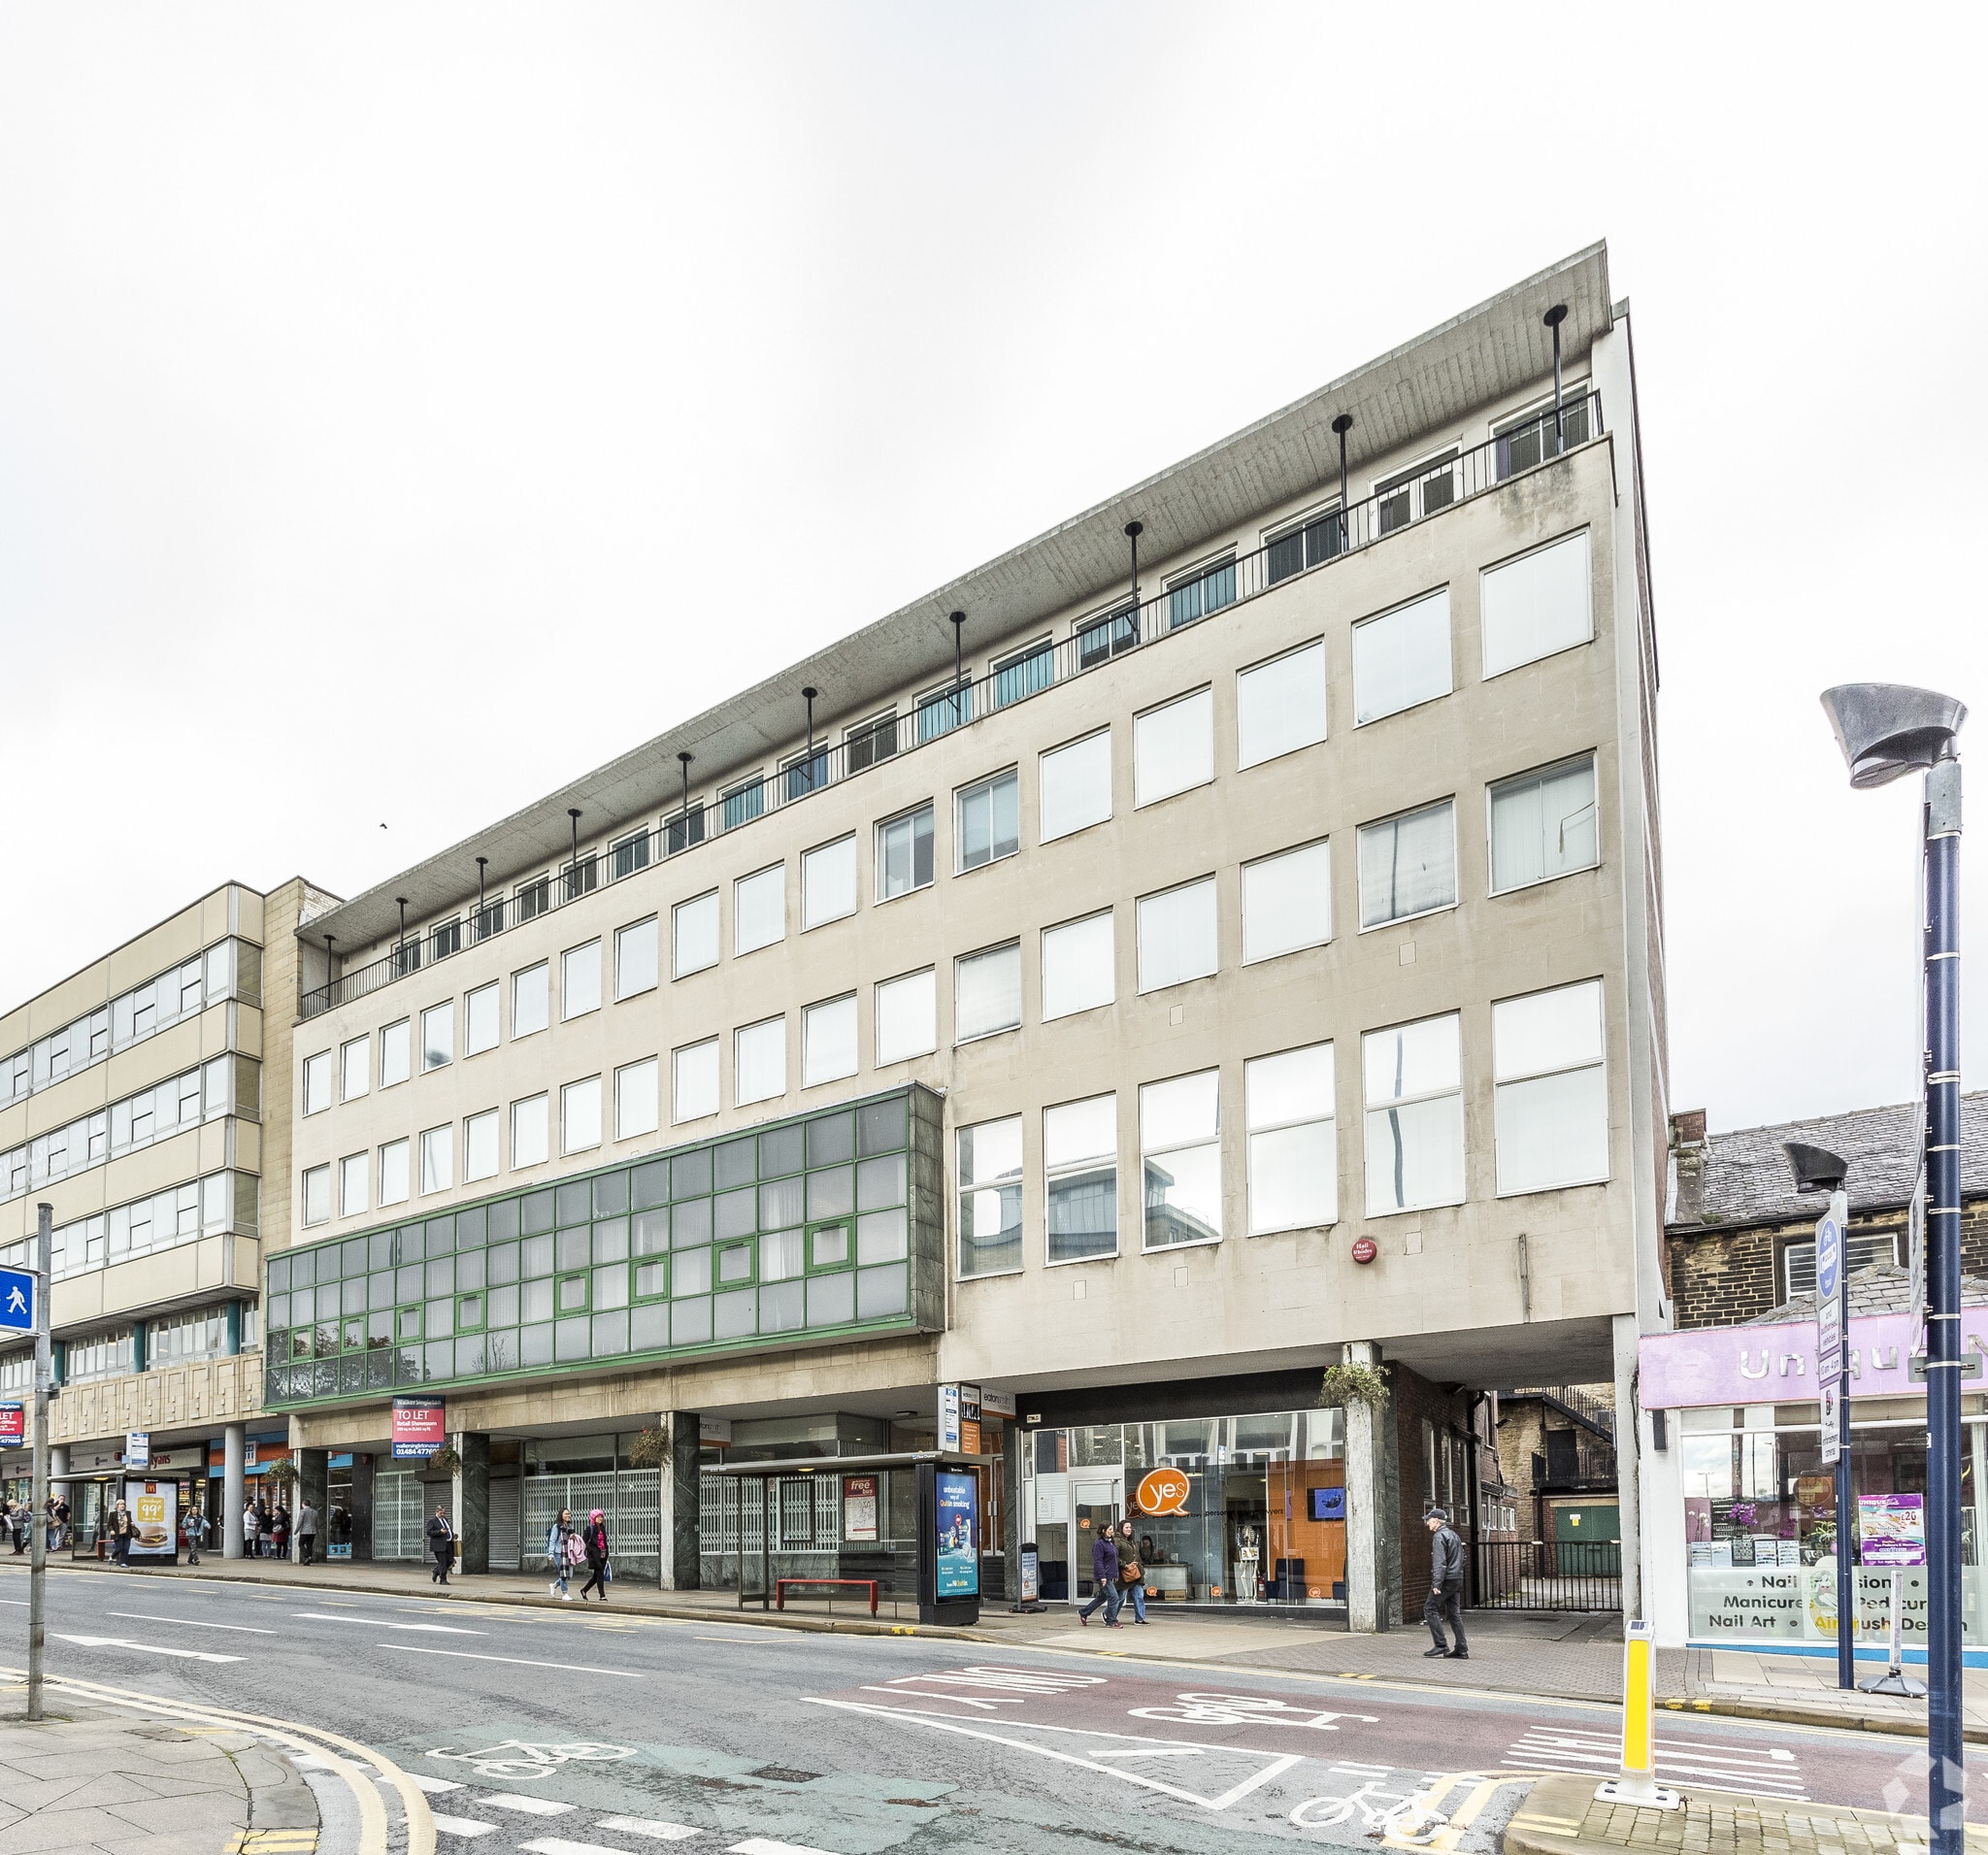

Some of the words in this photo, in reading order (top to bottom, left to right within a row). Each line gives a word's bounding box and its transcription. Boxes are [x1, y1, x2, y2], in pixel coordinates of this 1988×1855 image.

[397, 1410, 411, 1420] TO
[413, 1410, 429, 1420] LET
[851, 1480, 871, 1490] free
[1149, 1482, 1185, 1510] yes
[1709, 1614, 1743, 1627] Nail
[1751, 1615, 1776, 1628] Art
[1815, 1616, 1890, 1631] Airrush
[859, 1666, 1109, 1710] ONLY
[1500, 1725, 1812, 1802] TAXI
